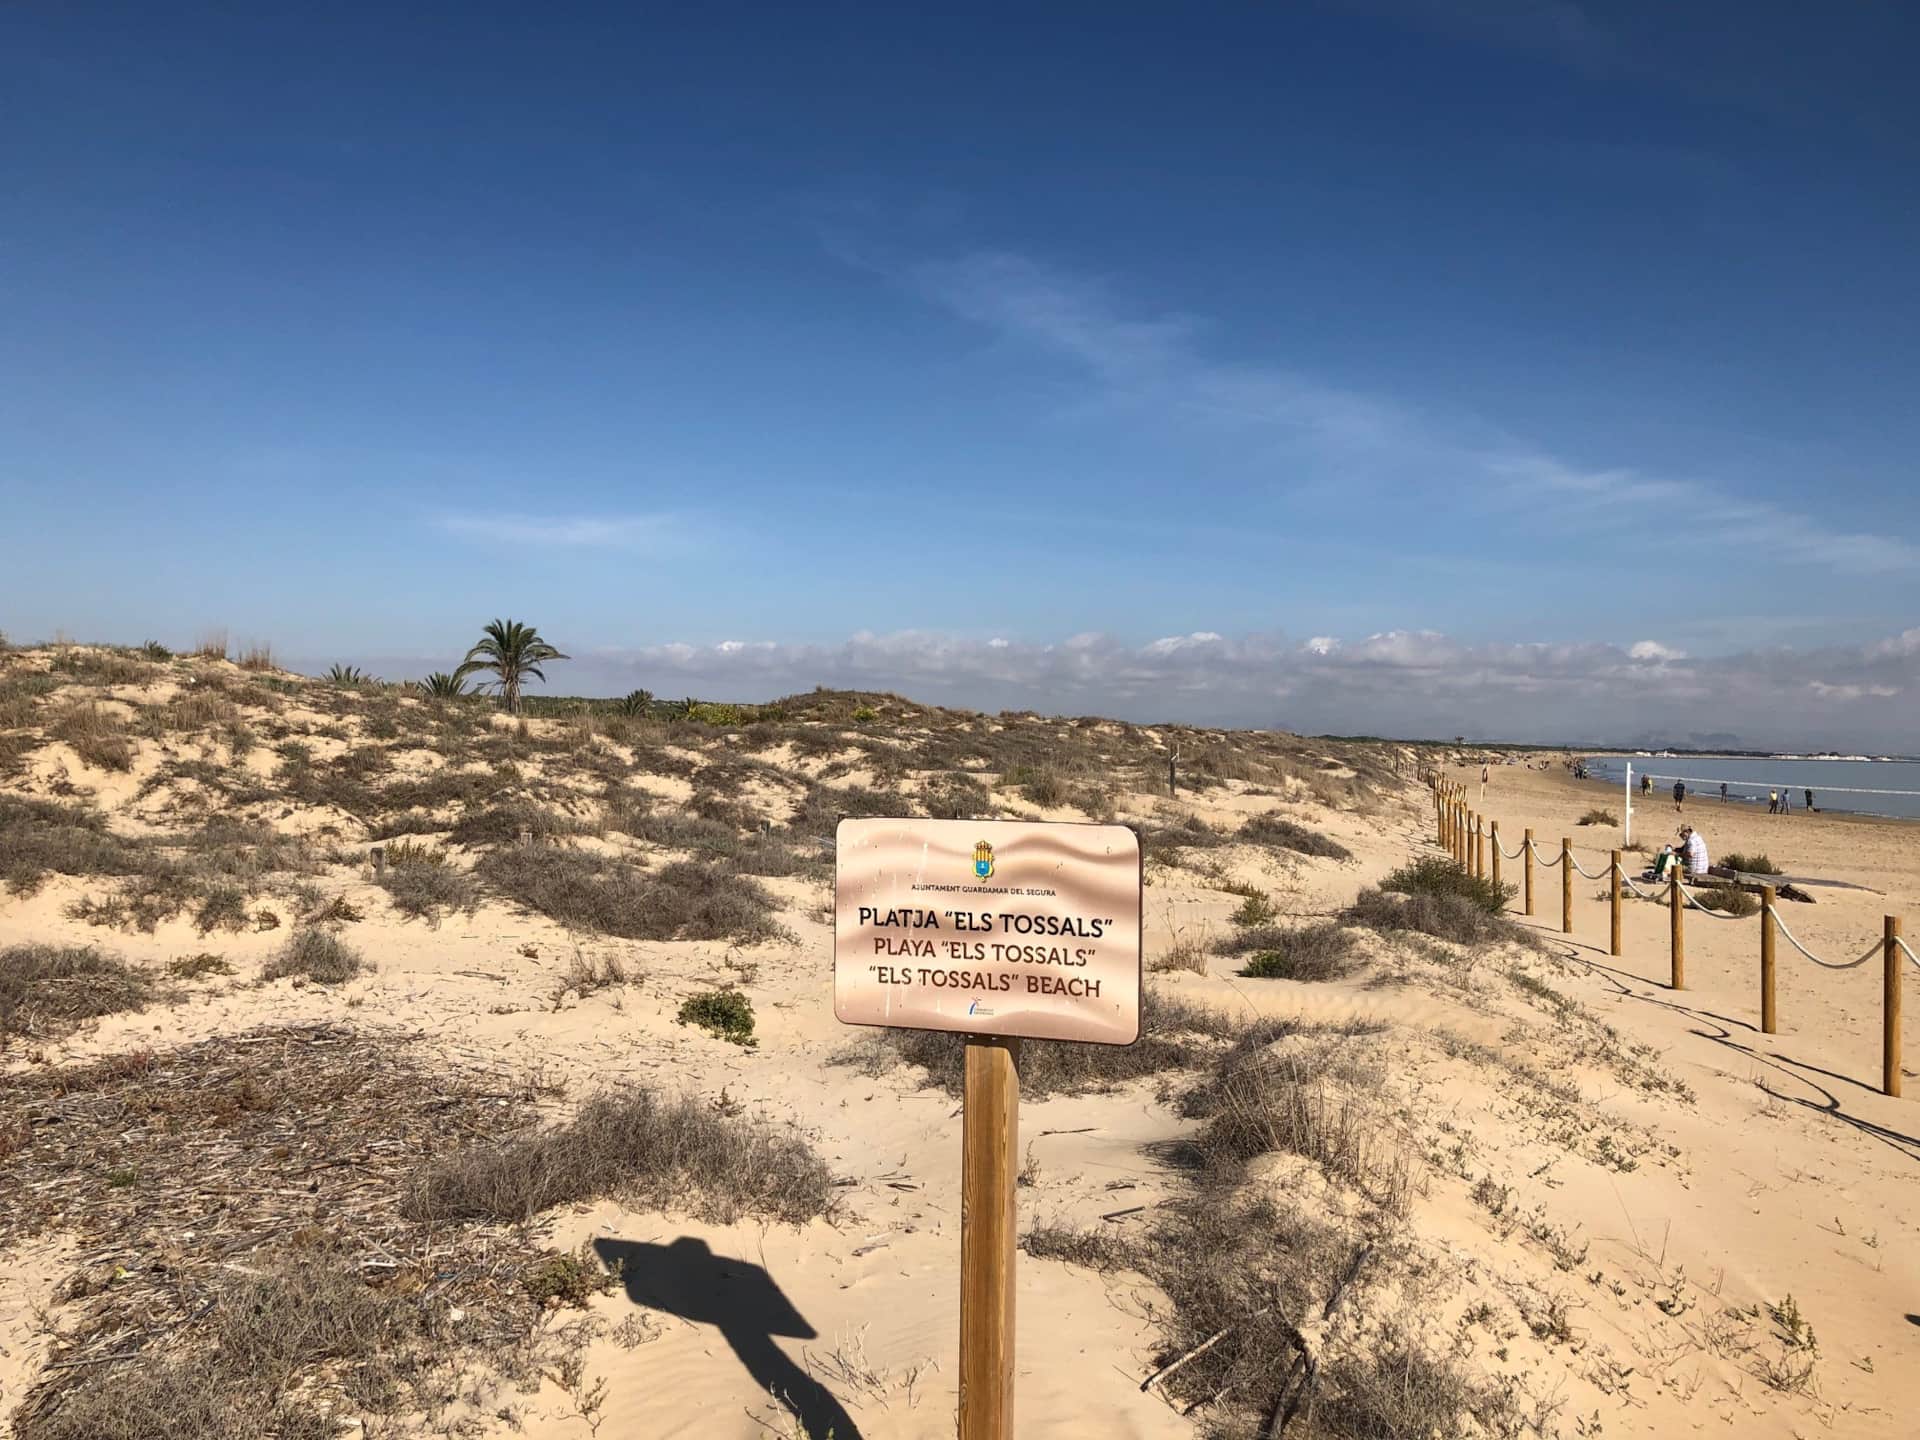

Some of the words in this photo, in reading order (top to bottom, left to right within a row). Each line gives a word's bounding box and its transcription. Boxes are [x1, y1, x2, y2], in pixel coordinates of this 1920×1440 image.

[911, 884, 960, 893] AJUNTAMENT
[962, 886, 1008, 895] GUARDAMAR
[1010, 887, 1024, 896] DEL
[1026, 888, 1057, 897] SEGURA
[858, 907, 940, 929] PLATJA
[945, 911, 992, 932] “ELS
[999, 914, 1113, 938] TOSSALS”
[873, 937, 936, 958] PLAYA
[941, 940, 985, 961] “ELS
[991, 944, 1096, 967] TOSSALS”
[869, 965, 912, 985] “ELS
[917, 968, 1019, 992] TOSSALS”
[1026, 975, 1101, 998] BEACH
